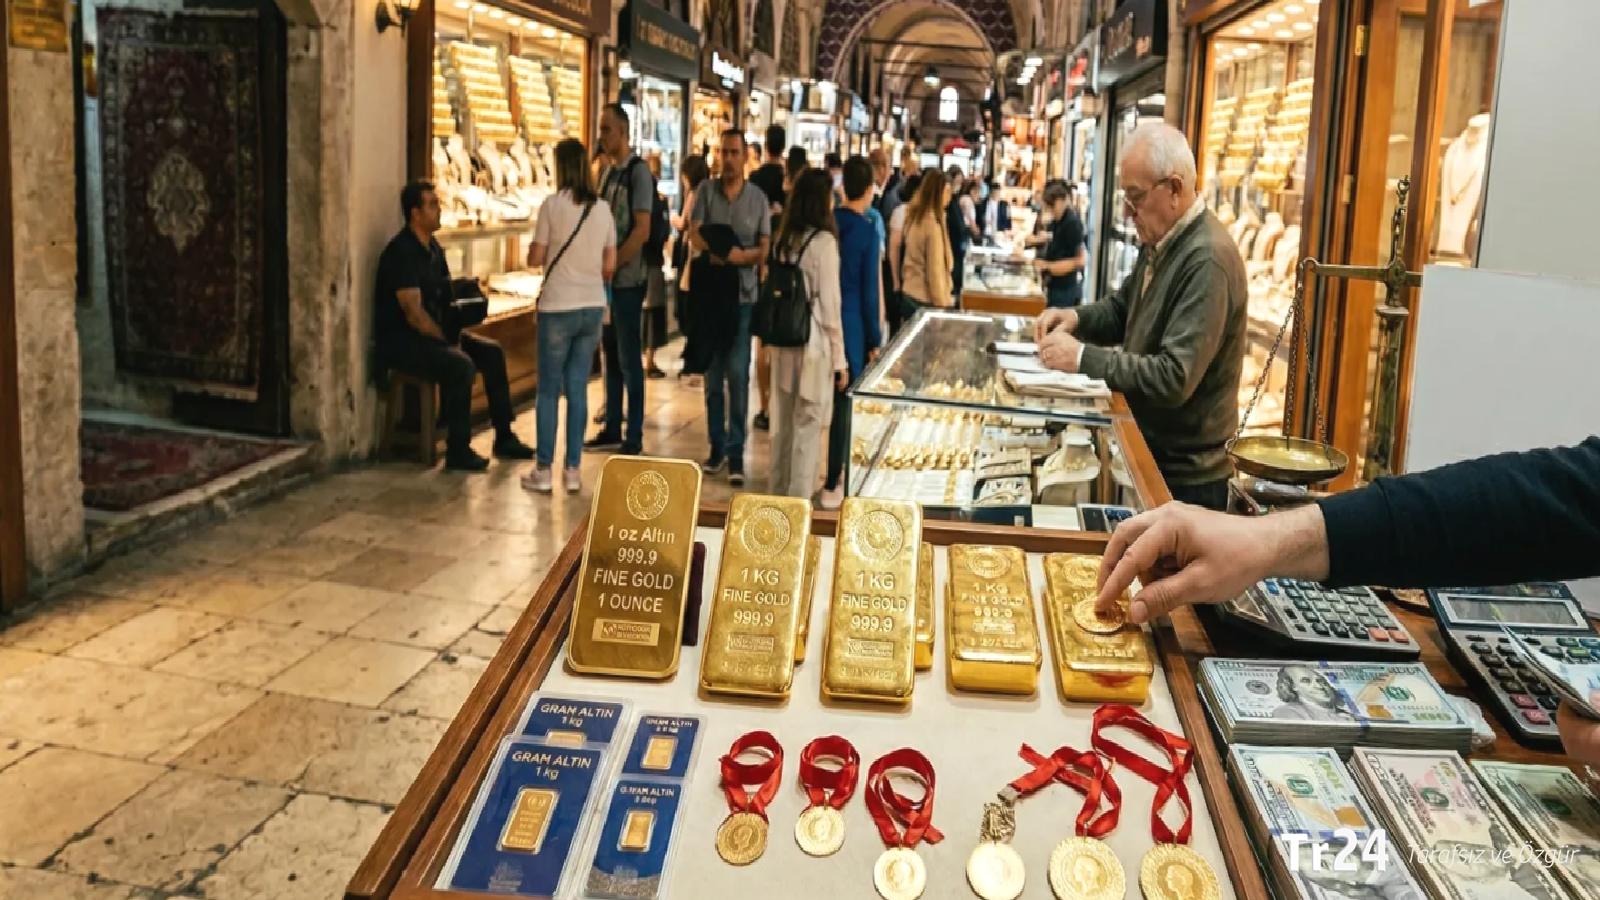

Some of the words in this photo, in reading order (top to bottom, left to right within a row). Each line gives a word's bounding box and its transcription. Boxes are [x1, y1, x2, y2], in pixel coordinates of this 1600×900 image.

[608, 524, 615, 539] 1
[618, 528, 638, 541] oz
[618, 547, 657, 565] 999.9
[594, 568, 629, 586] FINE
[632, 571, 674, 590] GOLD
[741, 567, 749, 583] 1
[754, 568, 779, 586] KG
[857, 571, 865, 588] 1
[870, 572, 895, 591] KG
[598, 592, 606, 609] 1
[610, 594, 663, 613] OUNCE
[723, 588, 752, 603] FINE
[755, 591, 790, 606] GOLD
[840, 592, 871, 609] FINE
[872, 596, 907, 612] GOLD
[733, 609, 774, 627] 999.9
[851, 613, 893, 632] 999.9
[541, 703, 577, 715] GRAM
[578, 707, 614, 719] ALTIN
[569, 717, 583, 727] kg
[512, 751, 551, 765] GRAM
[552, 755, 592, 769] ALTIN
[543, 768, 560, 780] kg
